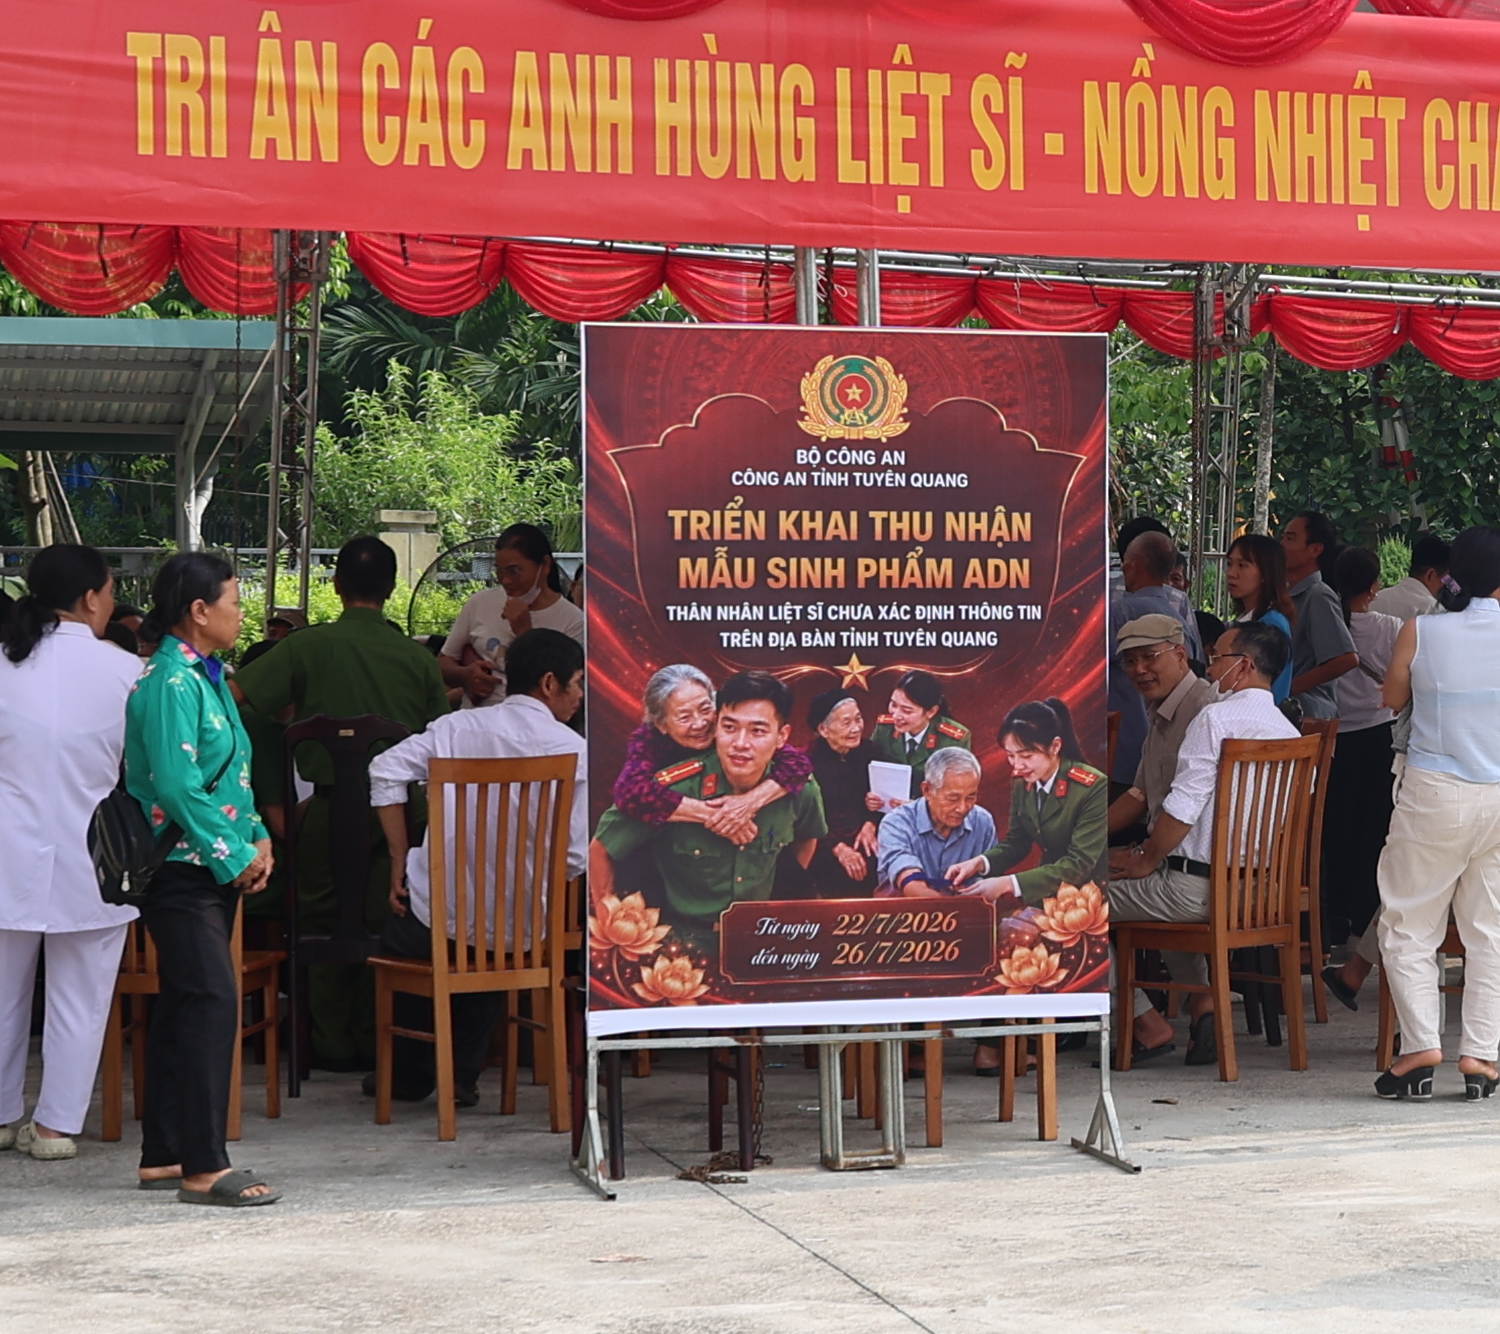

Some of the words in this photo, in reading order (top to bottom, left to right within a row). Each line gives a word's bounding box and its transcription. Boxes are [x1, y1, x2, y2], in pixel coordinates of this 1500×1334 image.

[126, 31, 228, 158] TRI
[250, 10, 339, 163] ÂN
[361, 18, 486, 170] CÁC
[506, 50, 634, 174] ANH
[654, 33, 816, 183] HÙNG
[835, 43, 952, 214] LIỆT
[970, 52, 1028, 191] SĨ
[1083, 42, 1236, 201] NỒNG
[1254, 69, 1407, 232] NHIỆT
[796, 446, 821, 468] BỘ
[825, 446, 876, 466] CÔNG
[880, 450, 906, 466] AN
[731, 468, 780, 487] CÔNG
[783, 471, 807, 486] AN
[811, 467, 849, 487] TỈNH
[853, 469, 906, 487] TUYÊN
[910, 472, 969, 488] QUANG
[668, 495, 766, 541] TRIỂN
[778, 510, 858, 541] KHAI
[869, 510, 933, 542] THU
[945, 505, 1031, 548] NHẬN
[678, 546, 756, 589] MẪU
[766, 557, 846, 589] SINH
[857, 545, 953, 589] PHẨM
[963, 557, 1030, 589] ADN
[666, 602, 712, 621] THÂN
[716, 602, 764, 621] NHÂN
[768, 602, 804, 625] LIỆT
[807, 602, 825, 621] SĨ
[827, 603, 874, 621] CHƯA
[877, 601, 911, 621] XÁC
[915, 605, 955, 624] ĐỊNH
[958, 601, 1014, 621] THÔNG
[1017, 604, 1042, 620] TIN
[720, 629, 764, 648] TRÊN
[767, 632, 797, 651] ĐỊA
[801, 628, 836, 648] BÀN
[840, 627, 879, 647] TỈNH
[883, 628, 937, 647] TUYÊN
[941, 630, 998, 648] QUANG
[754, 917, 781, 935] Từ
[781, 919, 821, 940] ngày
[832, 911, 959, 936] 22/7/2026
[751, 946, 779, 965] đến
[780, 949, 821, 970] ngày
[832, 938, 962, 965] 26/7/2026
